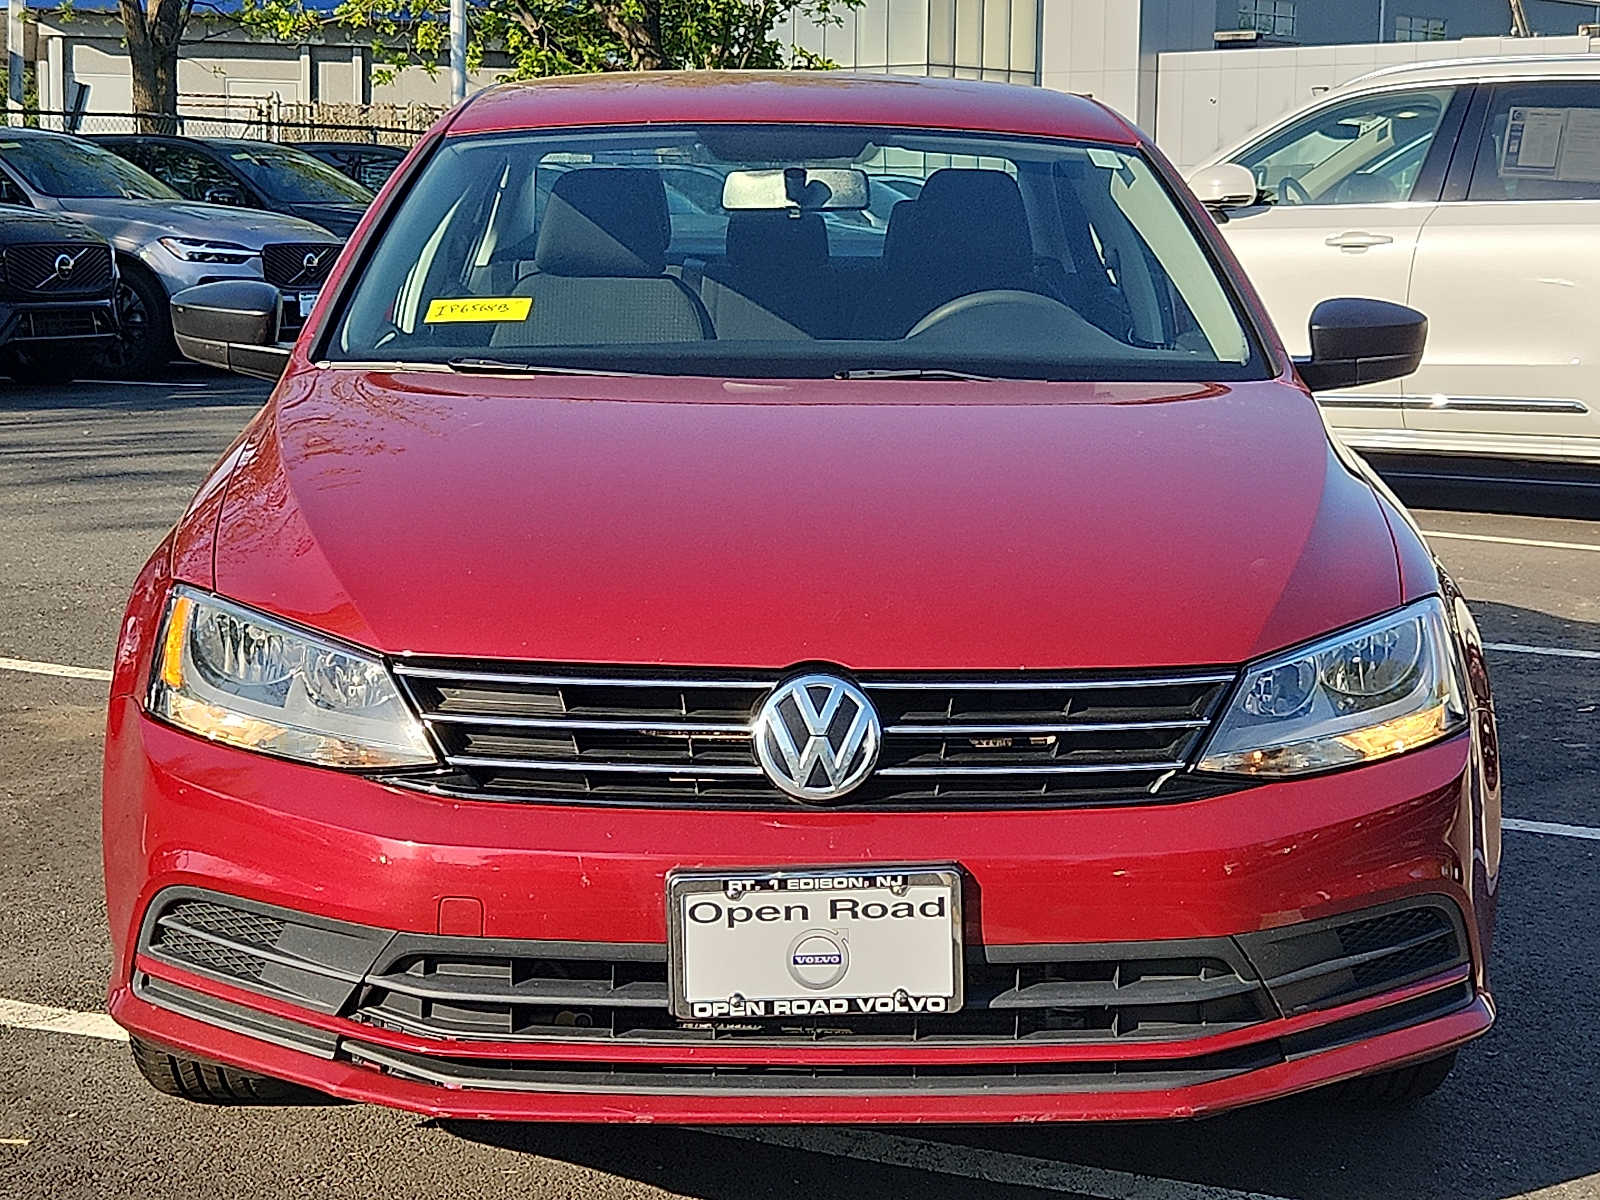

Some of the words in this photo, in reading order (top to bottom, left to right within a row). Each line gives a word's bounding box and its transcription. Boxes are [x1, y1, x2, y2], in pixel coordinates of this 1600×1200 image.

[787, 877, 870, 890] EDISON,
[876, 875, 903, 887] NJ
[688, 901, 809, 928] Open
[829, 896, 945, 919] Road
[794, 955, 841, 964] VOLVO
[693, 1000, 765, 1017] OPEN
[773, 998, 849, 1015] ROAD
[857, 996, 946, 1014] VOLVO
